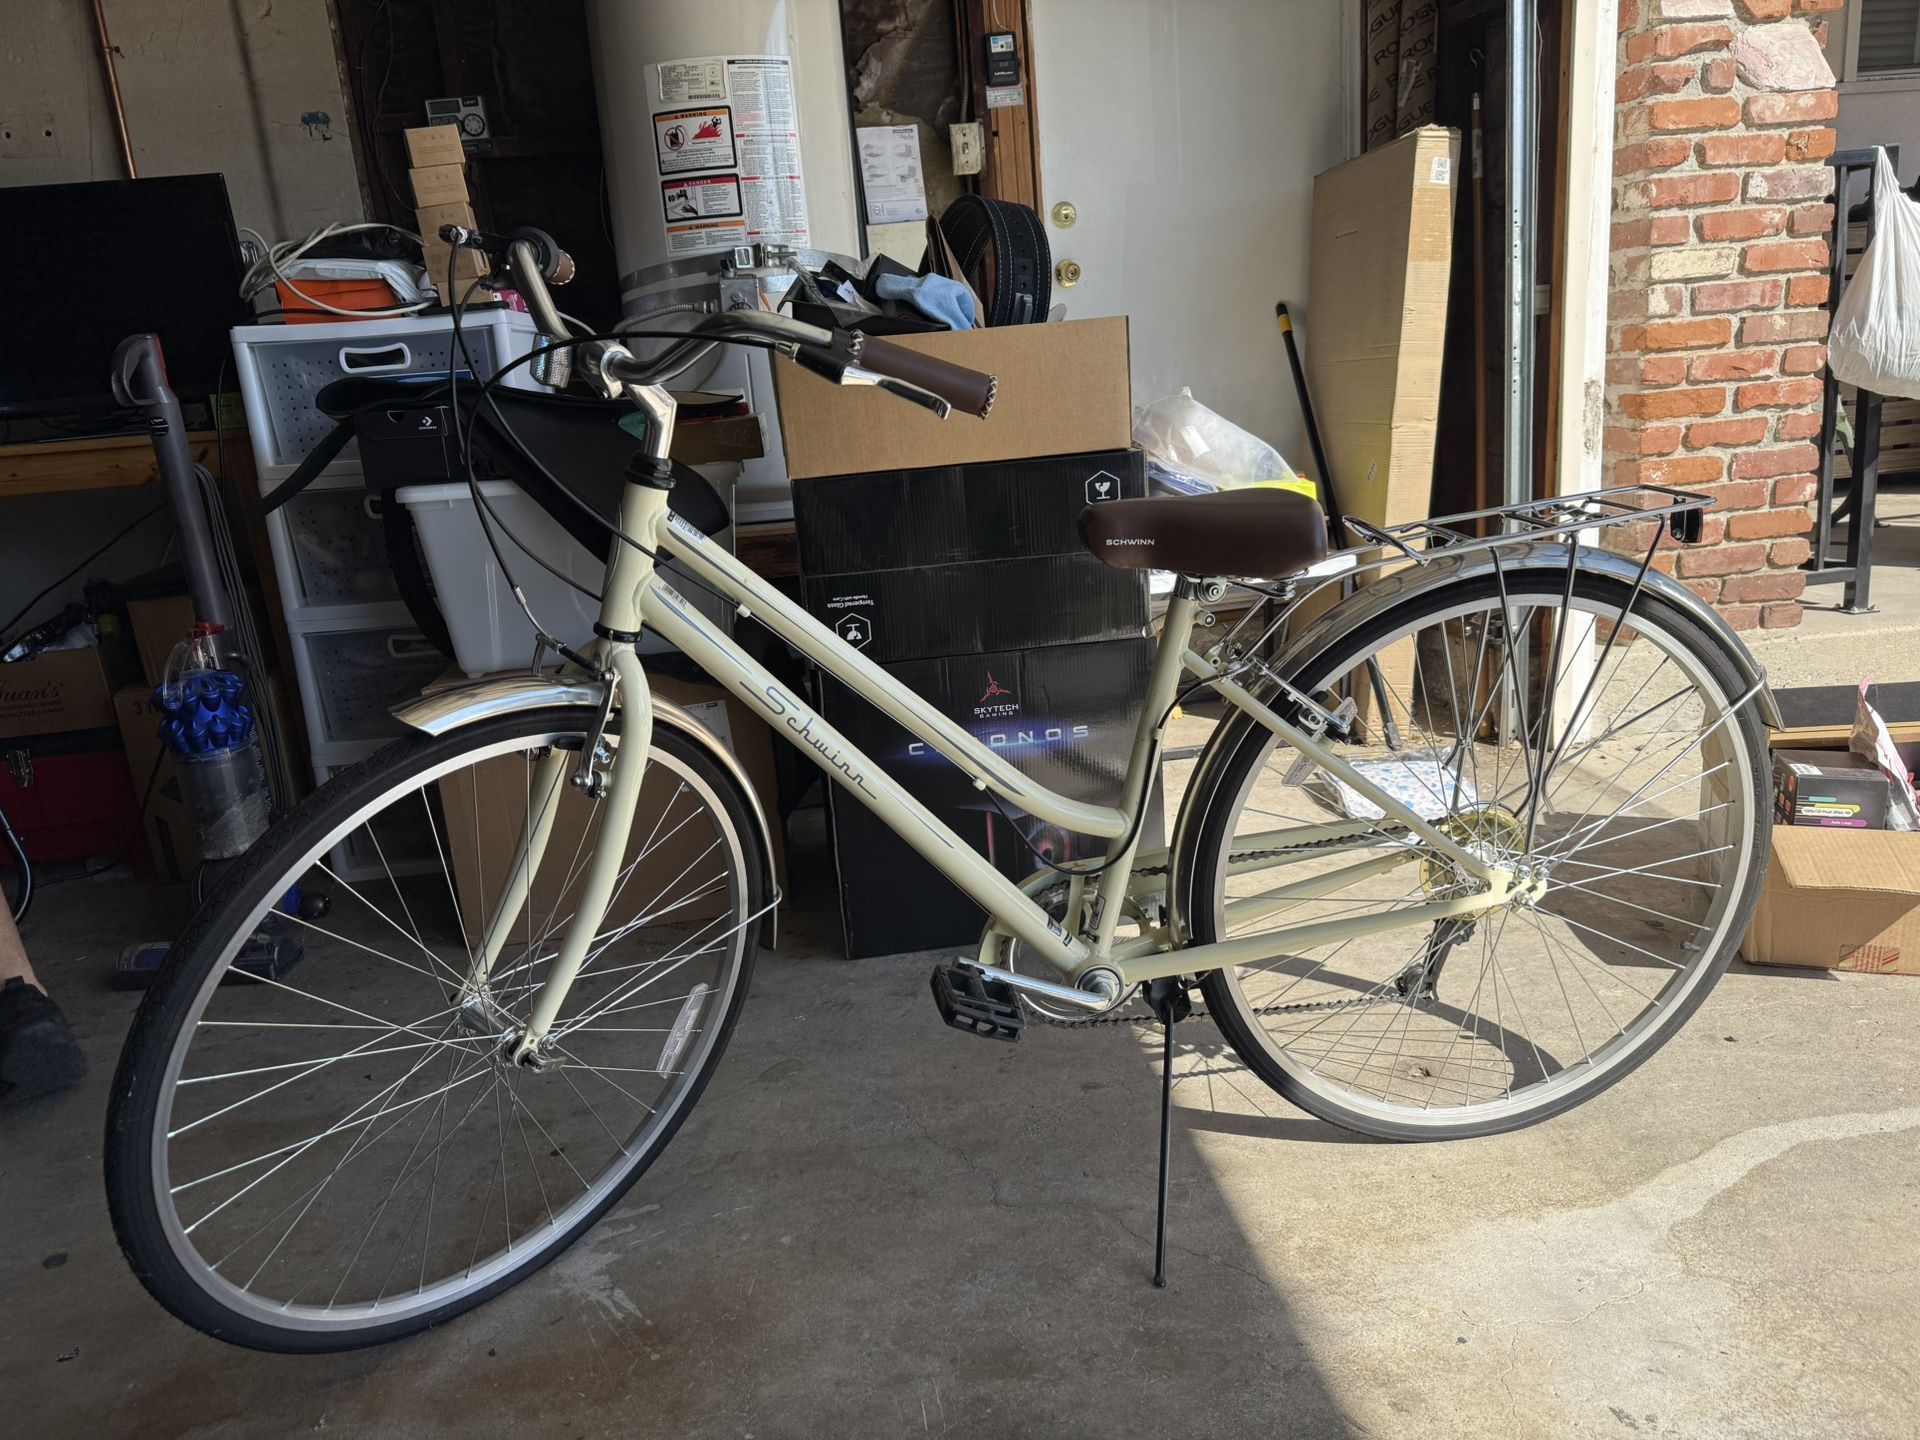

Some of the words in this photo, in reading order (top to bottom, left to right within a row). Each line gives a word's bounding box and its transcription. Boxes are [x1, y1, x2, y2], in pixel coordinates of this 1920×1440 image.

[680, 111, 708, 119] WARNING
[1105, 538, 1156, 546] SCHWINN
[826, 601, 844, 609] Glass
[844, 599, 876, 609] Tempered
[974, 703, 1020, 715] SKYTECH
[979, 711, 1014, 719] GAMING
[740, 682, 877, 800] Schwinn
[908, 725, 1088, 756] CONOS
